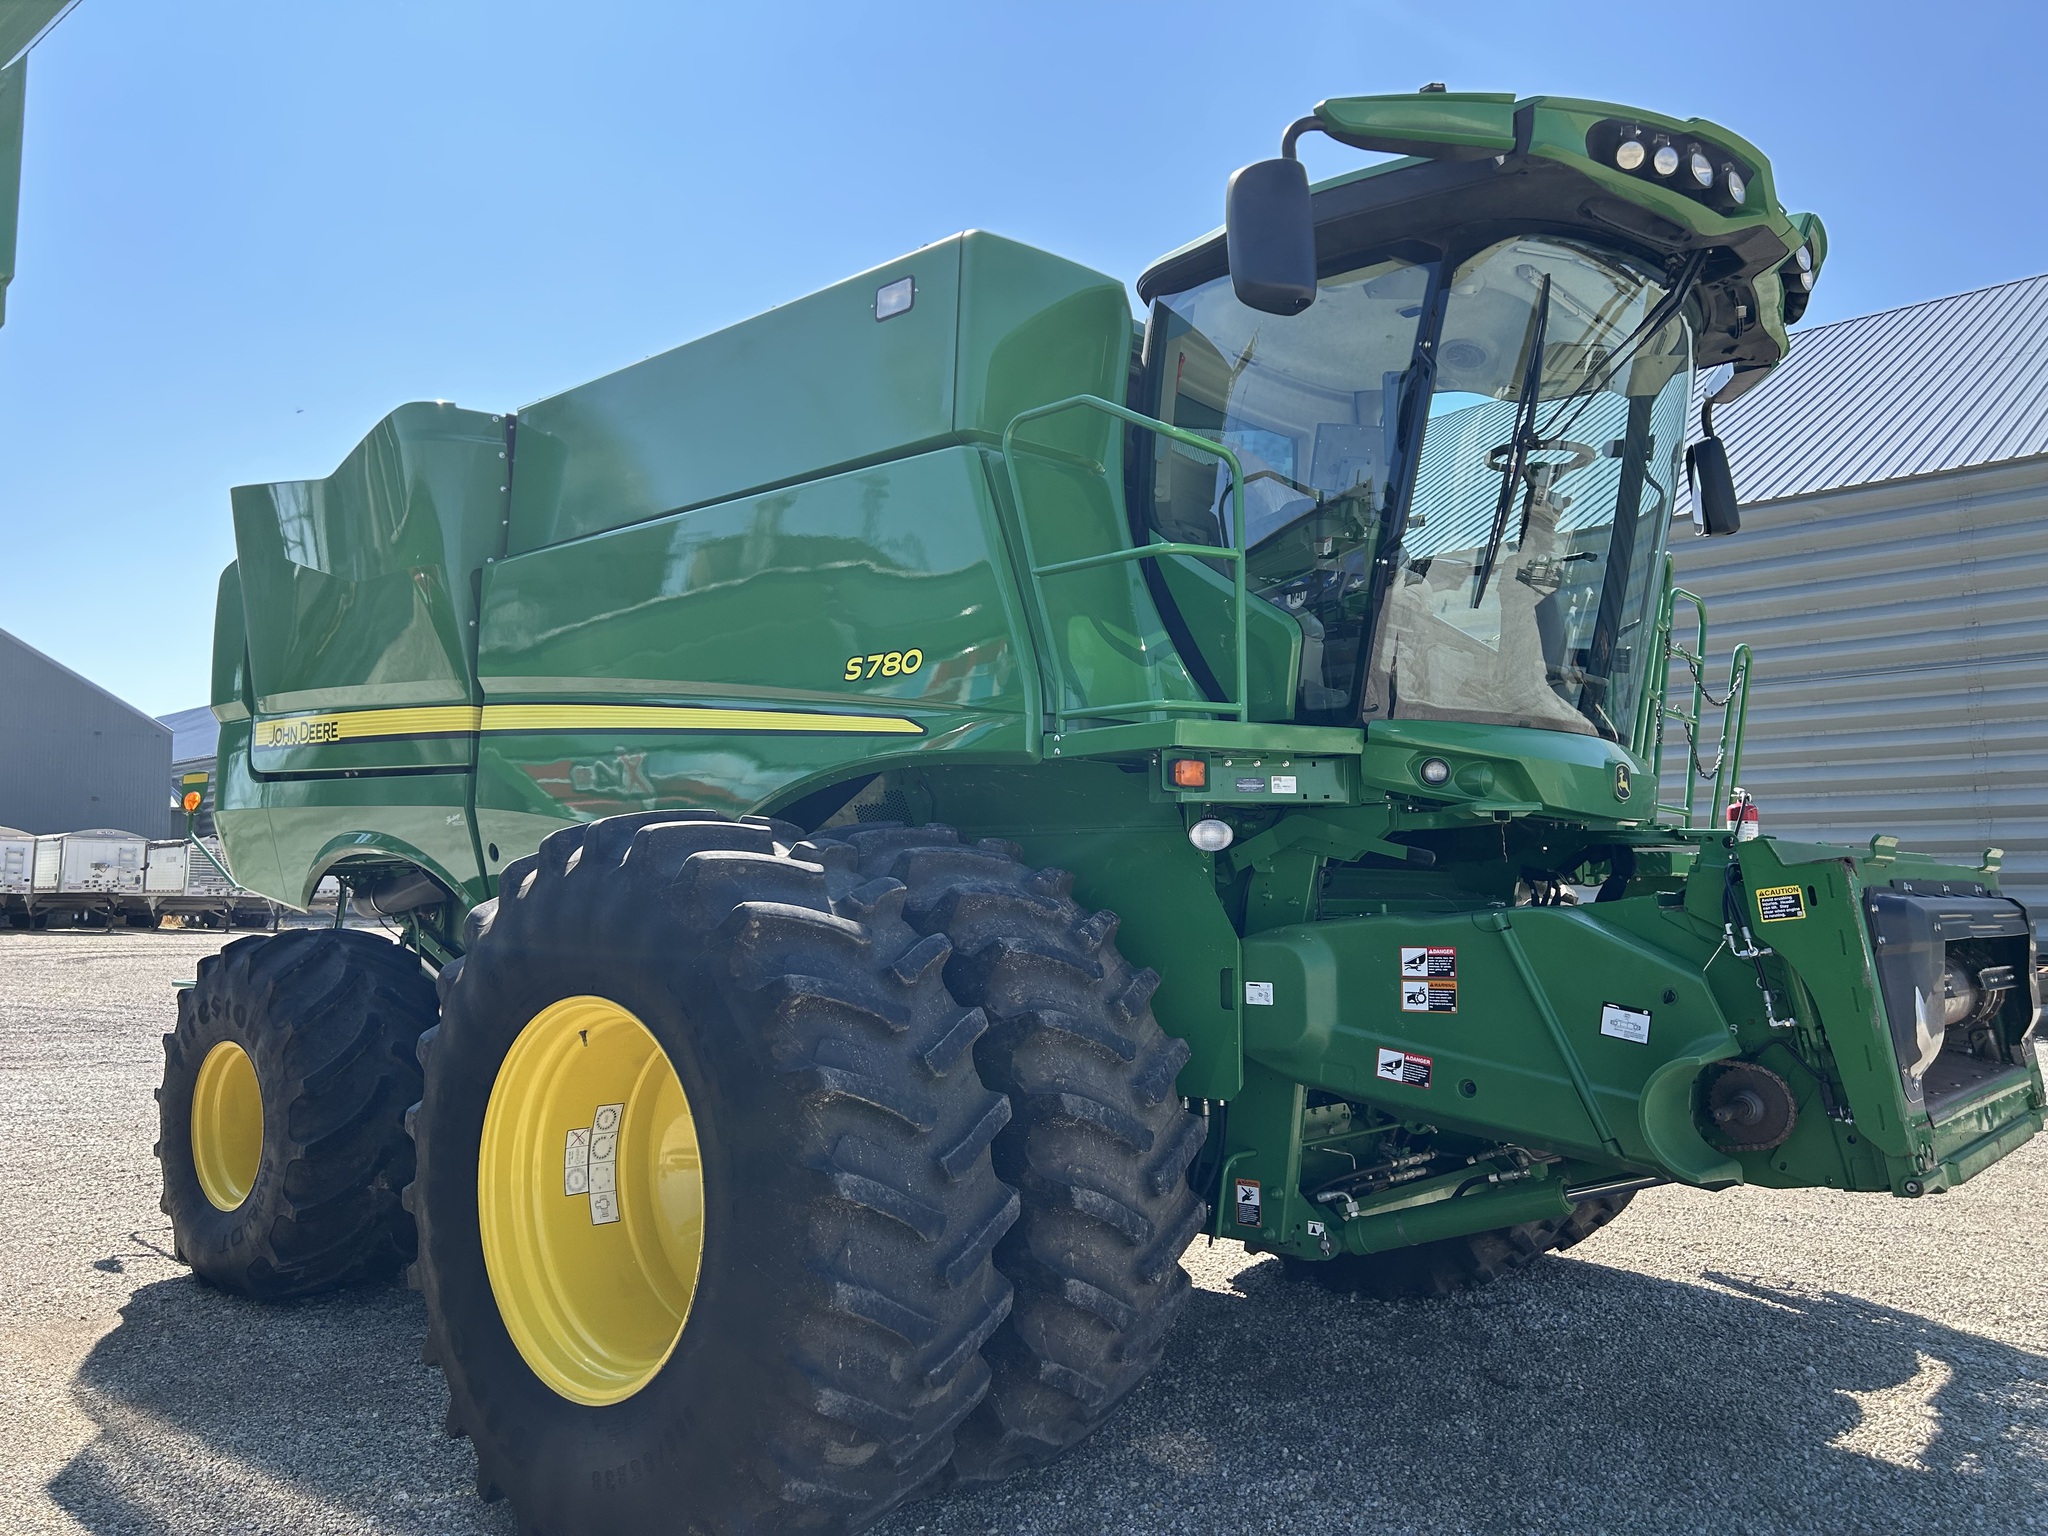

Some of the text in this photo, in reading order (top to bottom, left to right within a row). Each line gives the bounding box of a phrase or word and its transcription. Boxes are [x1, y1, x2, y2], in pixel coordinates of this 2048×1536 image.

[843, 647, 923, 682] S780
[268, 721, 339, 744] JOHN DEERE
[1765, 887, 1799, 896] CAUTION
[1410, 1056, 1431, 1065] DANGER
